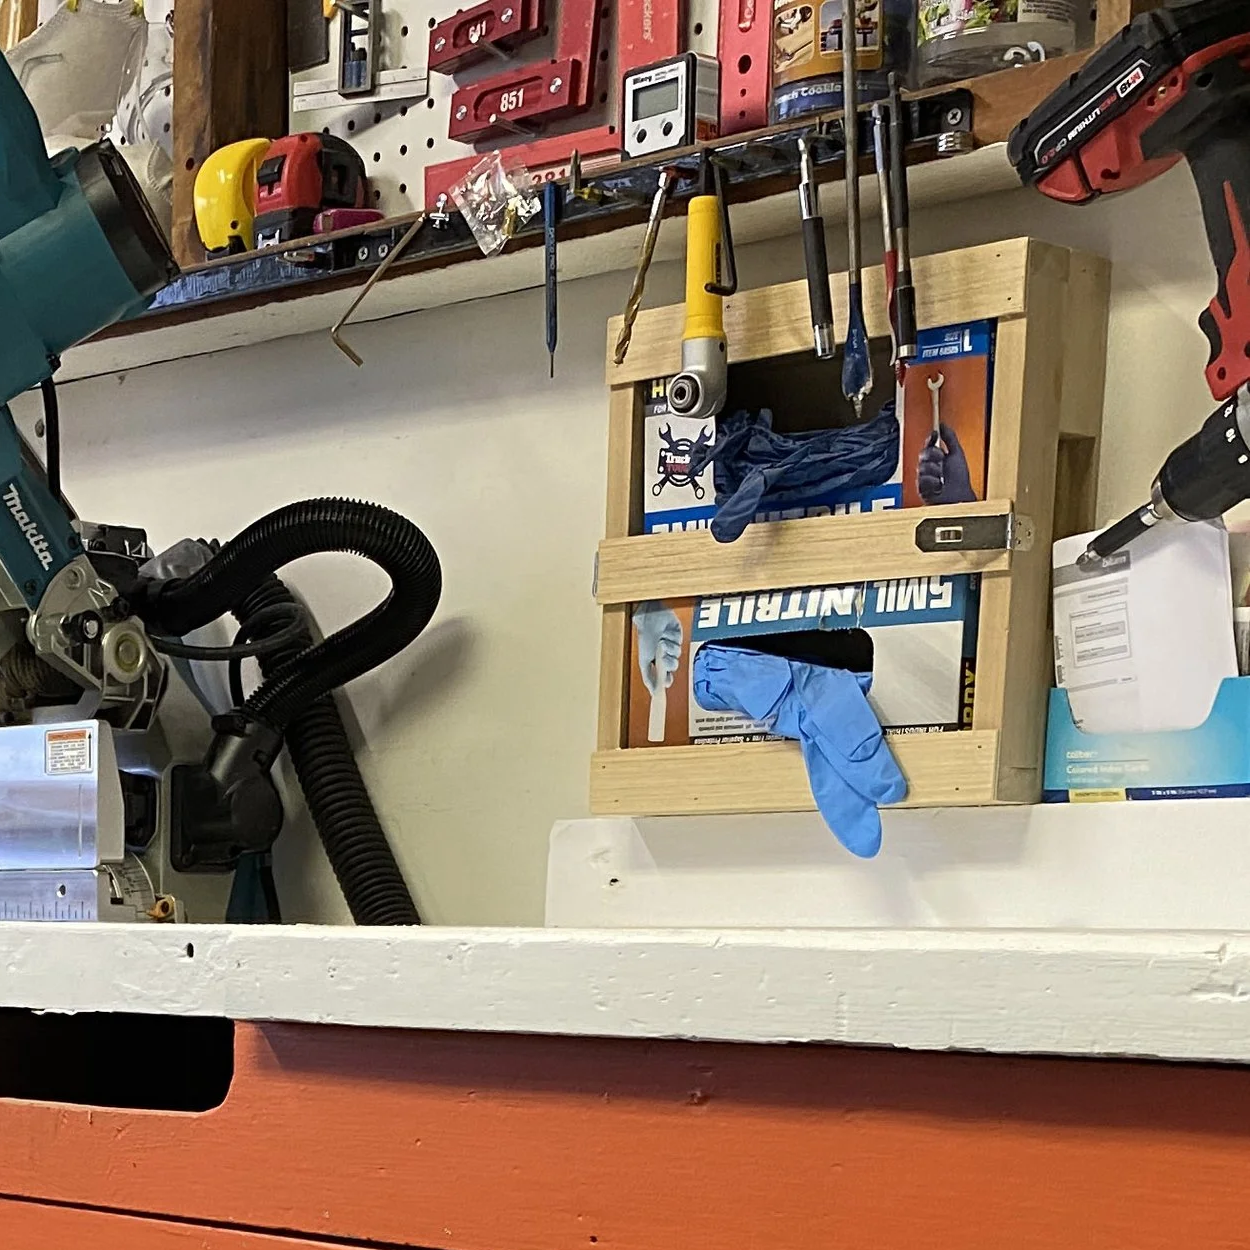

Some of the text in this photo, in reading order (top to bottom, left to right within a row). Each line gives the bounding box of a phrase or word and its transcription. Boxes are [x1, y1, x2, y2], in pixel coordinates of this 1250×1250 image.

[500, 88, 525, 112] 851
[963, 328, 973, 352] L
[666, 452, 691, 465] Truck
[3, 483, 54, 571] makita
[697, 586, 859, 629] NITRILE
[873, 575, 953, 614] 5MIL
